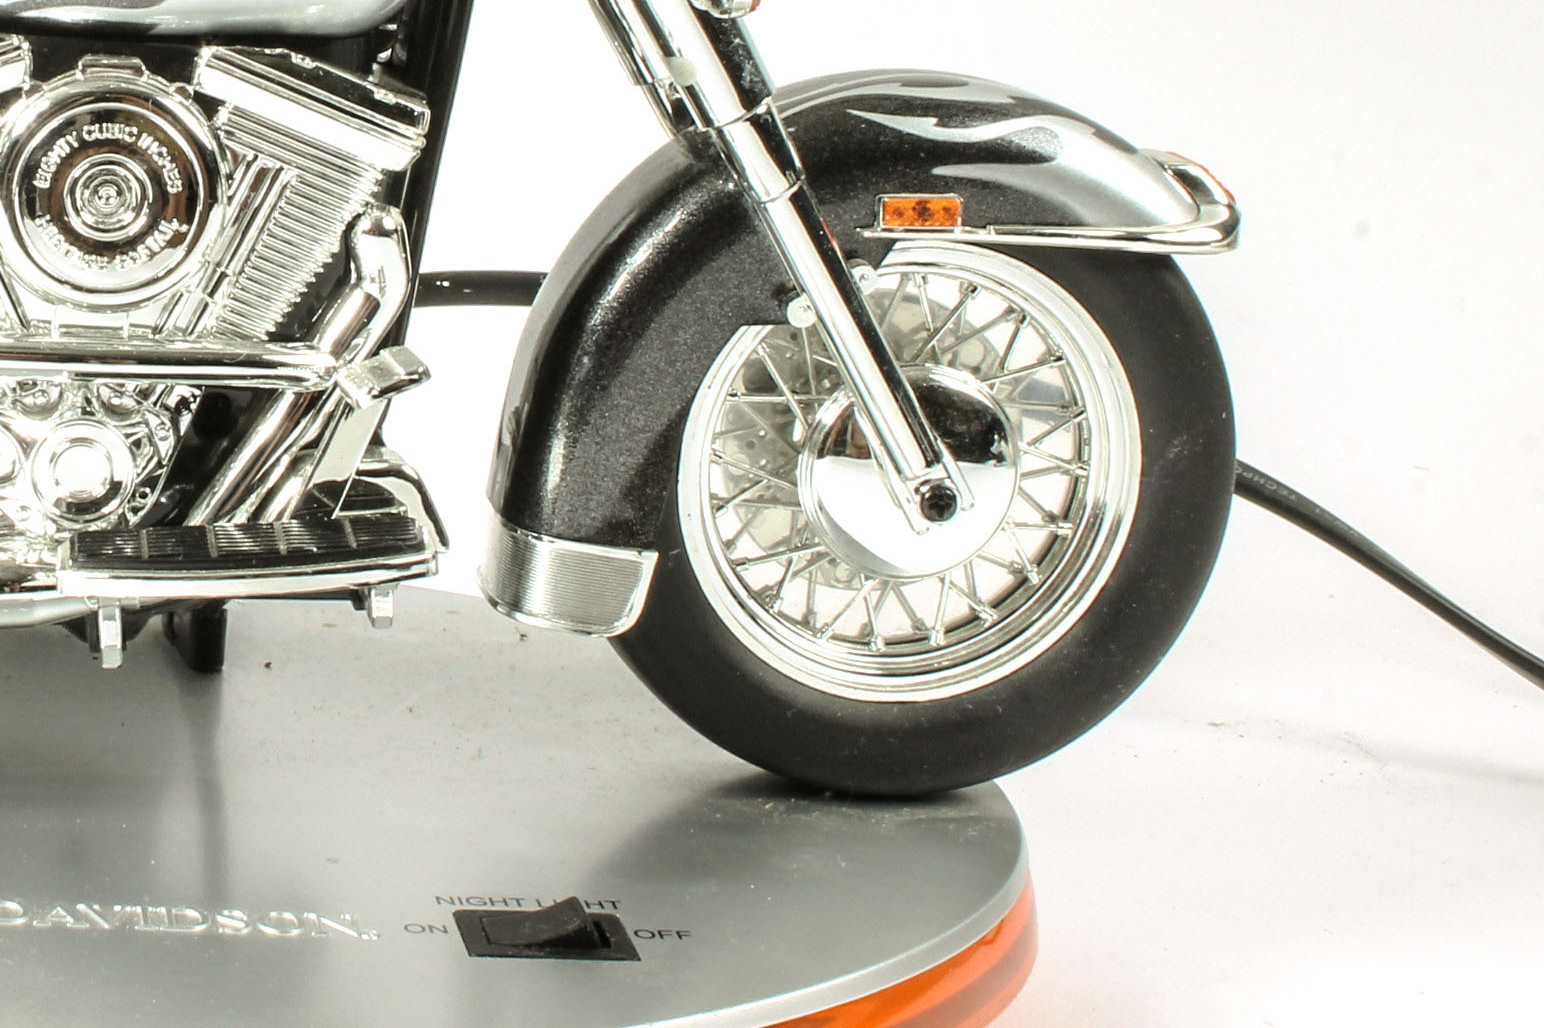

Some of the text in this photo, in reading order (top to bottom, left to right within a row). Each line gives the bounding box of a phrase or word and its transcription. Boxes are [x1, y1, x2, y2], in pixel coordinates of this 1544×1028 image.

[33, 123, 184, 194] EIGHTY CUBIC INCHES
[434, 895, 622, 910] NIGHT LIHT
[403, 922, 449, 934] ON
[633, 928, 693, 941] OFF
